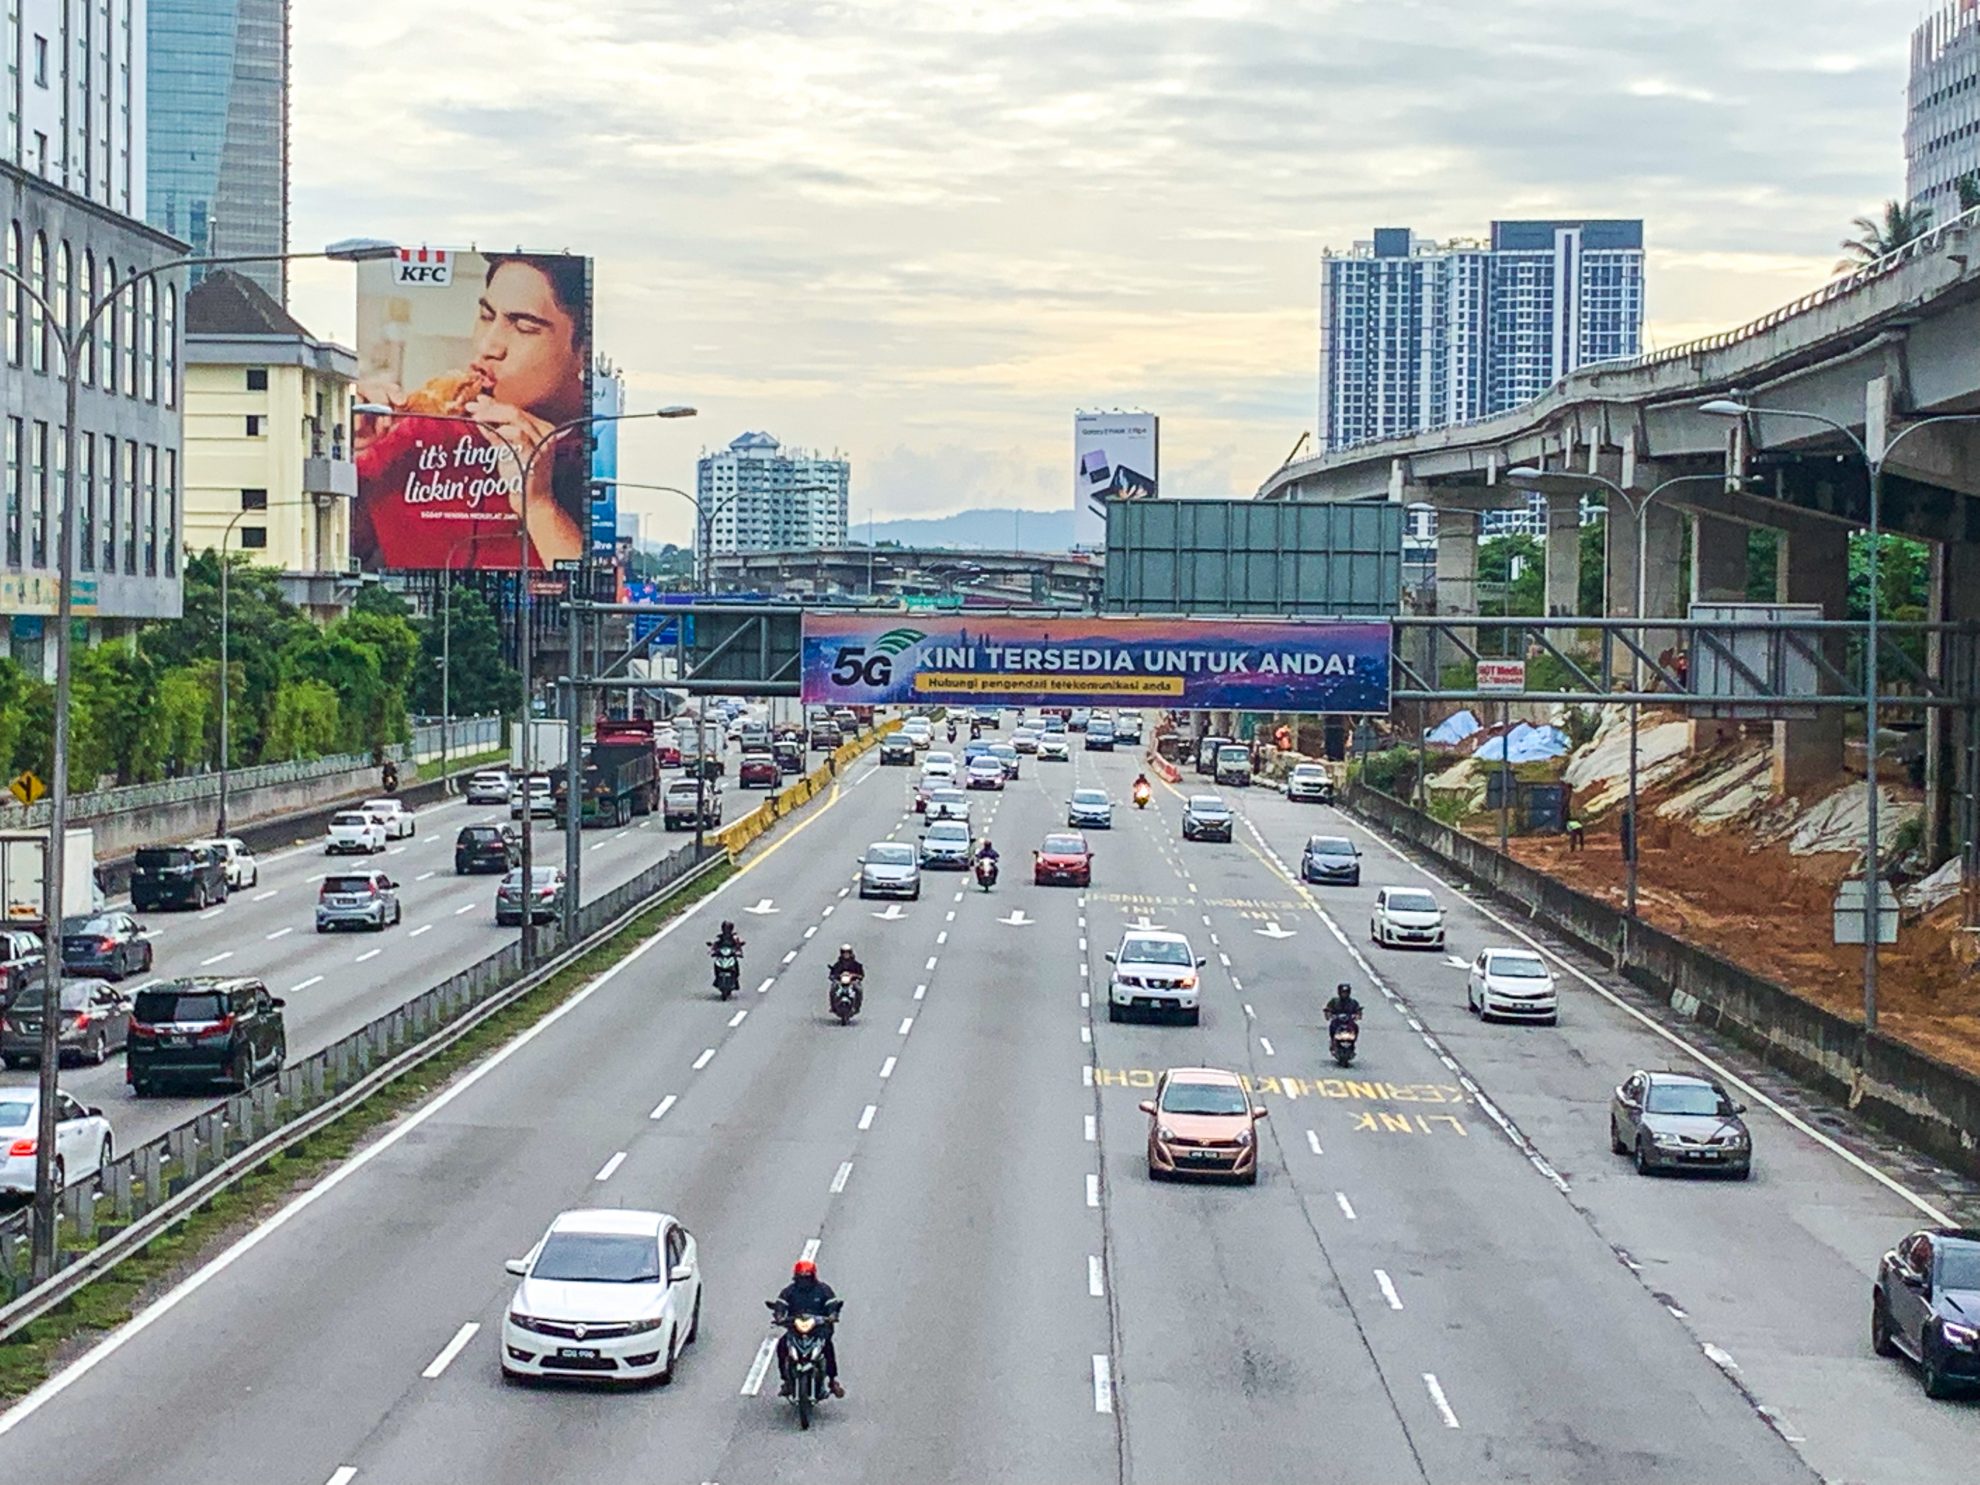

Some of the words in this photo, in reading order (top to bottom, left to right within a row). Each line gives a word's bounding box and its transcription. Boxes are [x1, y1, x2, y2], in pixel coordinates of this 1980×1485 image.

[400, 266, 447, 282] KFC
[452, 434, 522, 474] finger
[404, 470, 470, 503] lickin'
[831, 646, 892, 686] 5G
[916, 647, 975, 669] KINI
[986, 647, 1134, 671] TERSEDIA
[1143, 649, 1248, 673] UNTUK
[1257, 652, 1355, 675] ANDA!
[928, 677, 978, 688] Hubungi
[1142, 682, 1171, 691] anda
[1350, 1111, 1467, 1137] LINK
